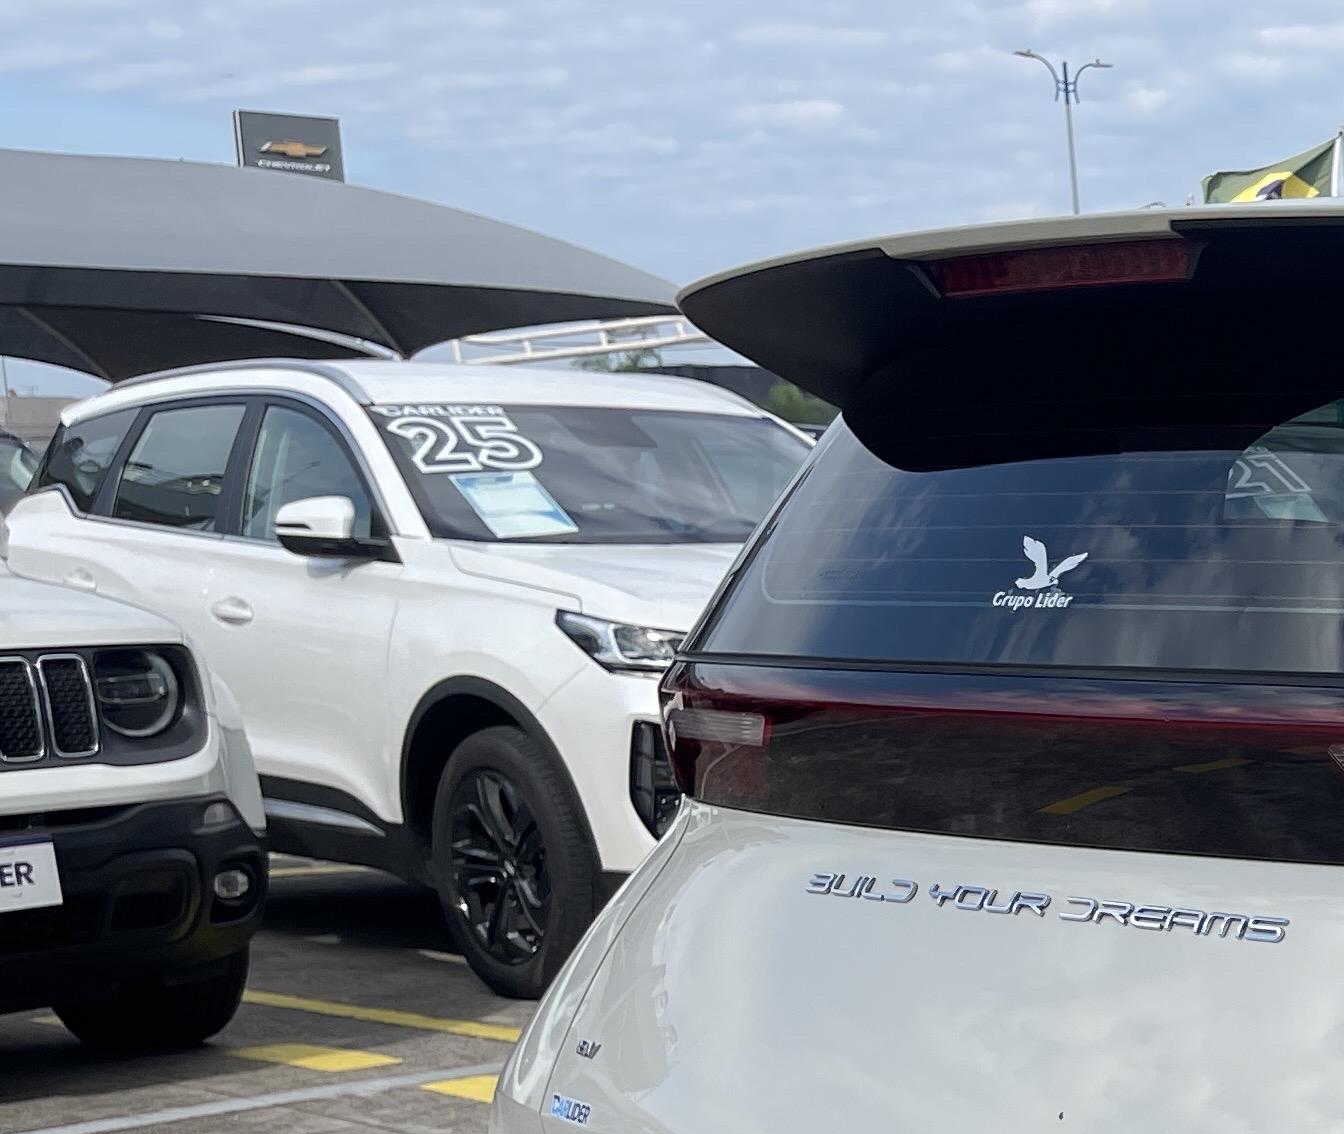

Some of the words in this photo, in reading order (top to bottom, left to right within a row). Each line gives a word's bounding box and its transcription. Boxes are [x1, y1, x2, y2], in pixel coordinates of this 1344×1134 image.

[387, 415, 543, 474] 25
[992, 591, 1033, 611] Grupo
[805, 871, 918, 904] BUILD
[929, 883, 1051, 917] YOUR
[1059, 896, 1290, 944] DREAMS
